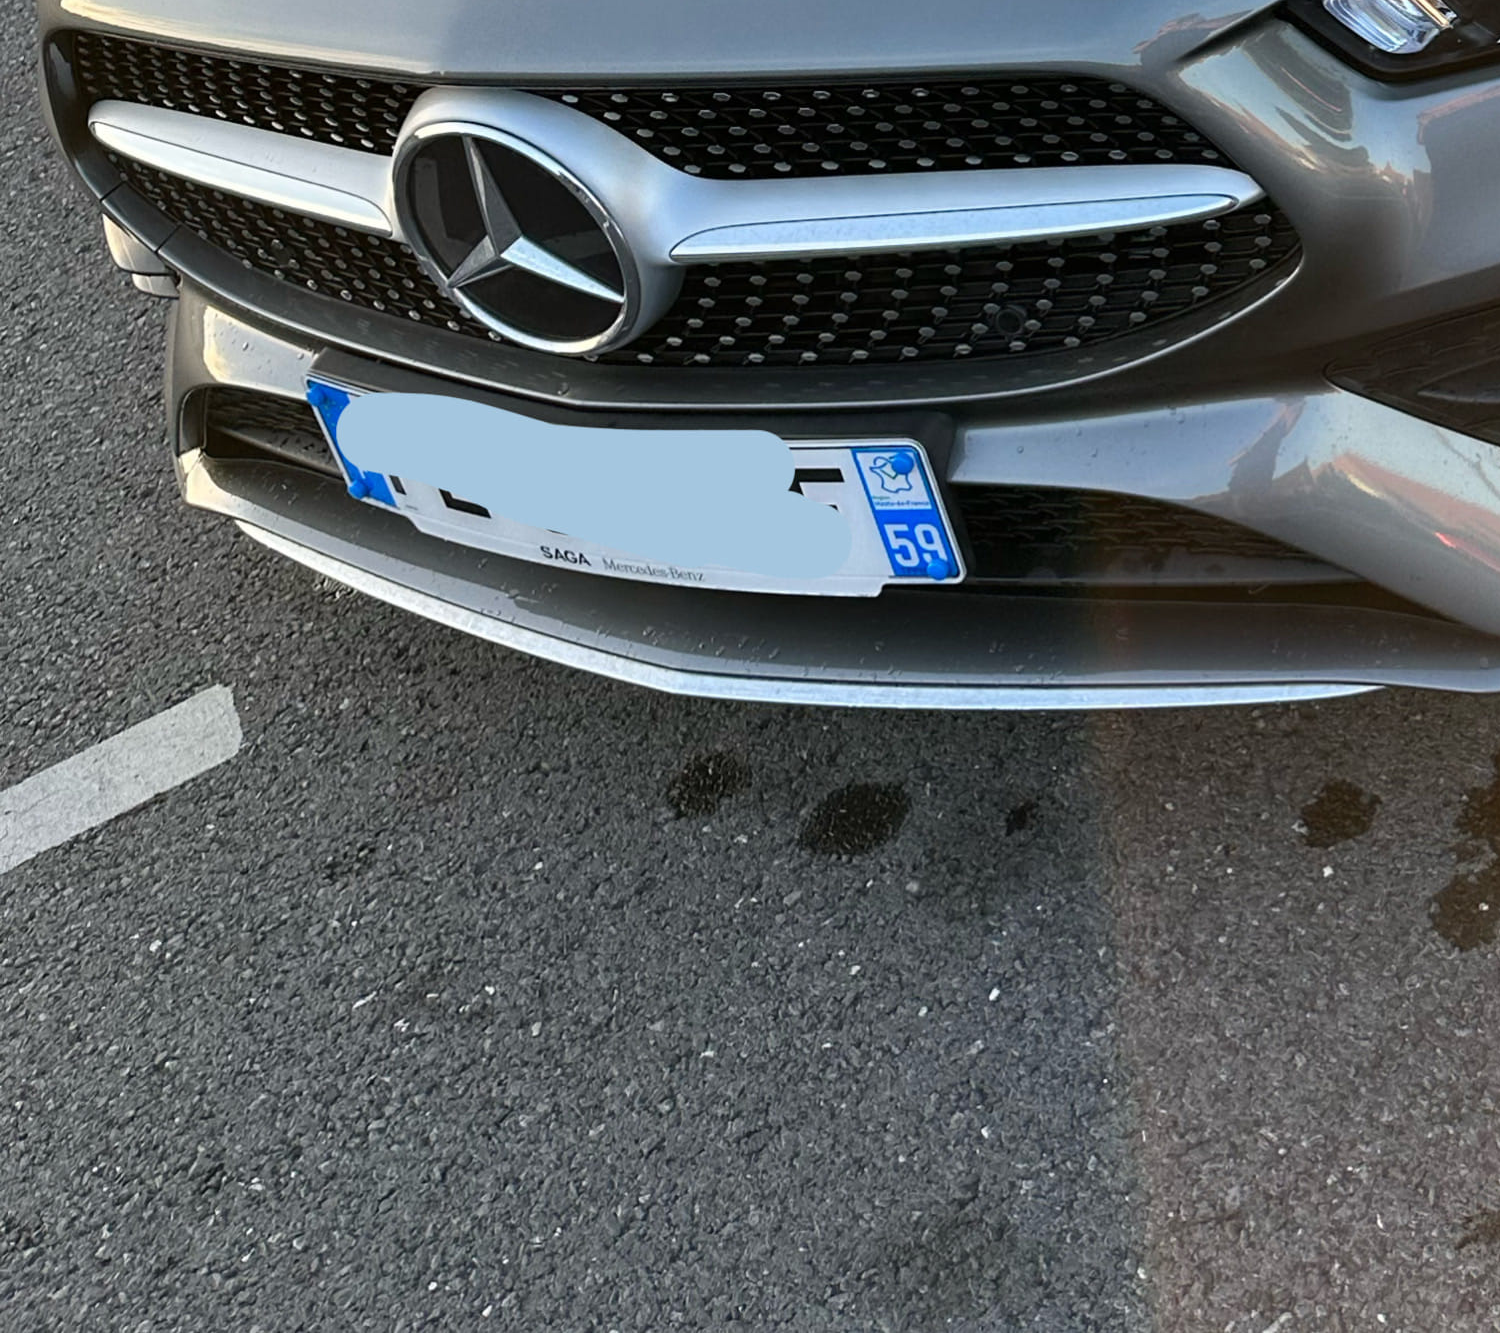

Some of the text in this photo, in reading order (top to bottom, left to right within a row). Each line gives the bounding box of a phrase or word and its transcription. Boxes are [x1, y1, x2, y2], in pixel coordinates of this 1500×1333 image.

[540, 545, 705, 581] SAGA Mercedes-Benz
[883, 523, 949, 567] 59
